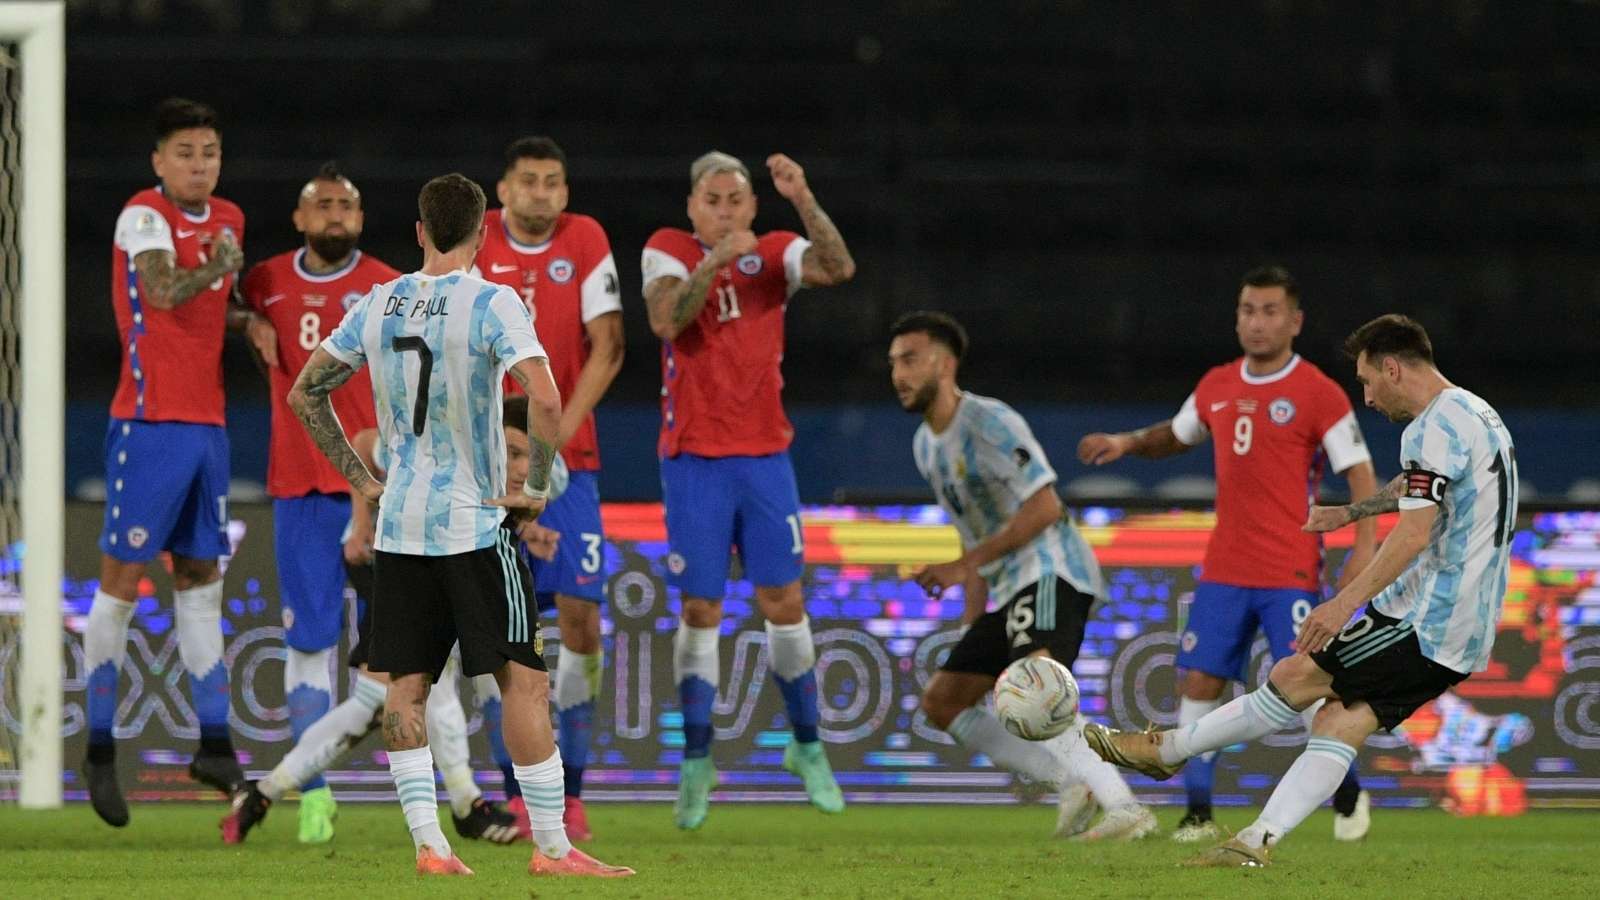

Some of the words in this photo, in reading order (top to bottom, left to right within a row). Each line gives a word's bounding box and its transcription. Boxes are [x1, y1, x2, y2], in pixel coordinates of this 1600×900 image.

[383, 295, 409, 317] DE
[410, 295, 449, 318] PAUL
[715, 284, 741, 323] 11
[299, 311, 321, 351] 8
[391, 335, 434, 438] 7
[1232, 415, 1253, 455] 9
[1431, 476, 1446, 501] C
[580, 532, 601, 574] 3
